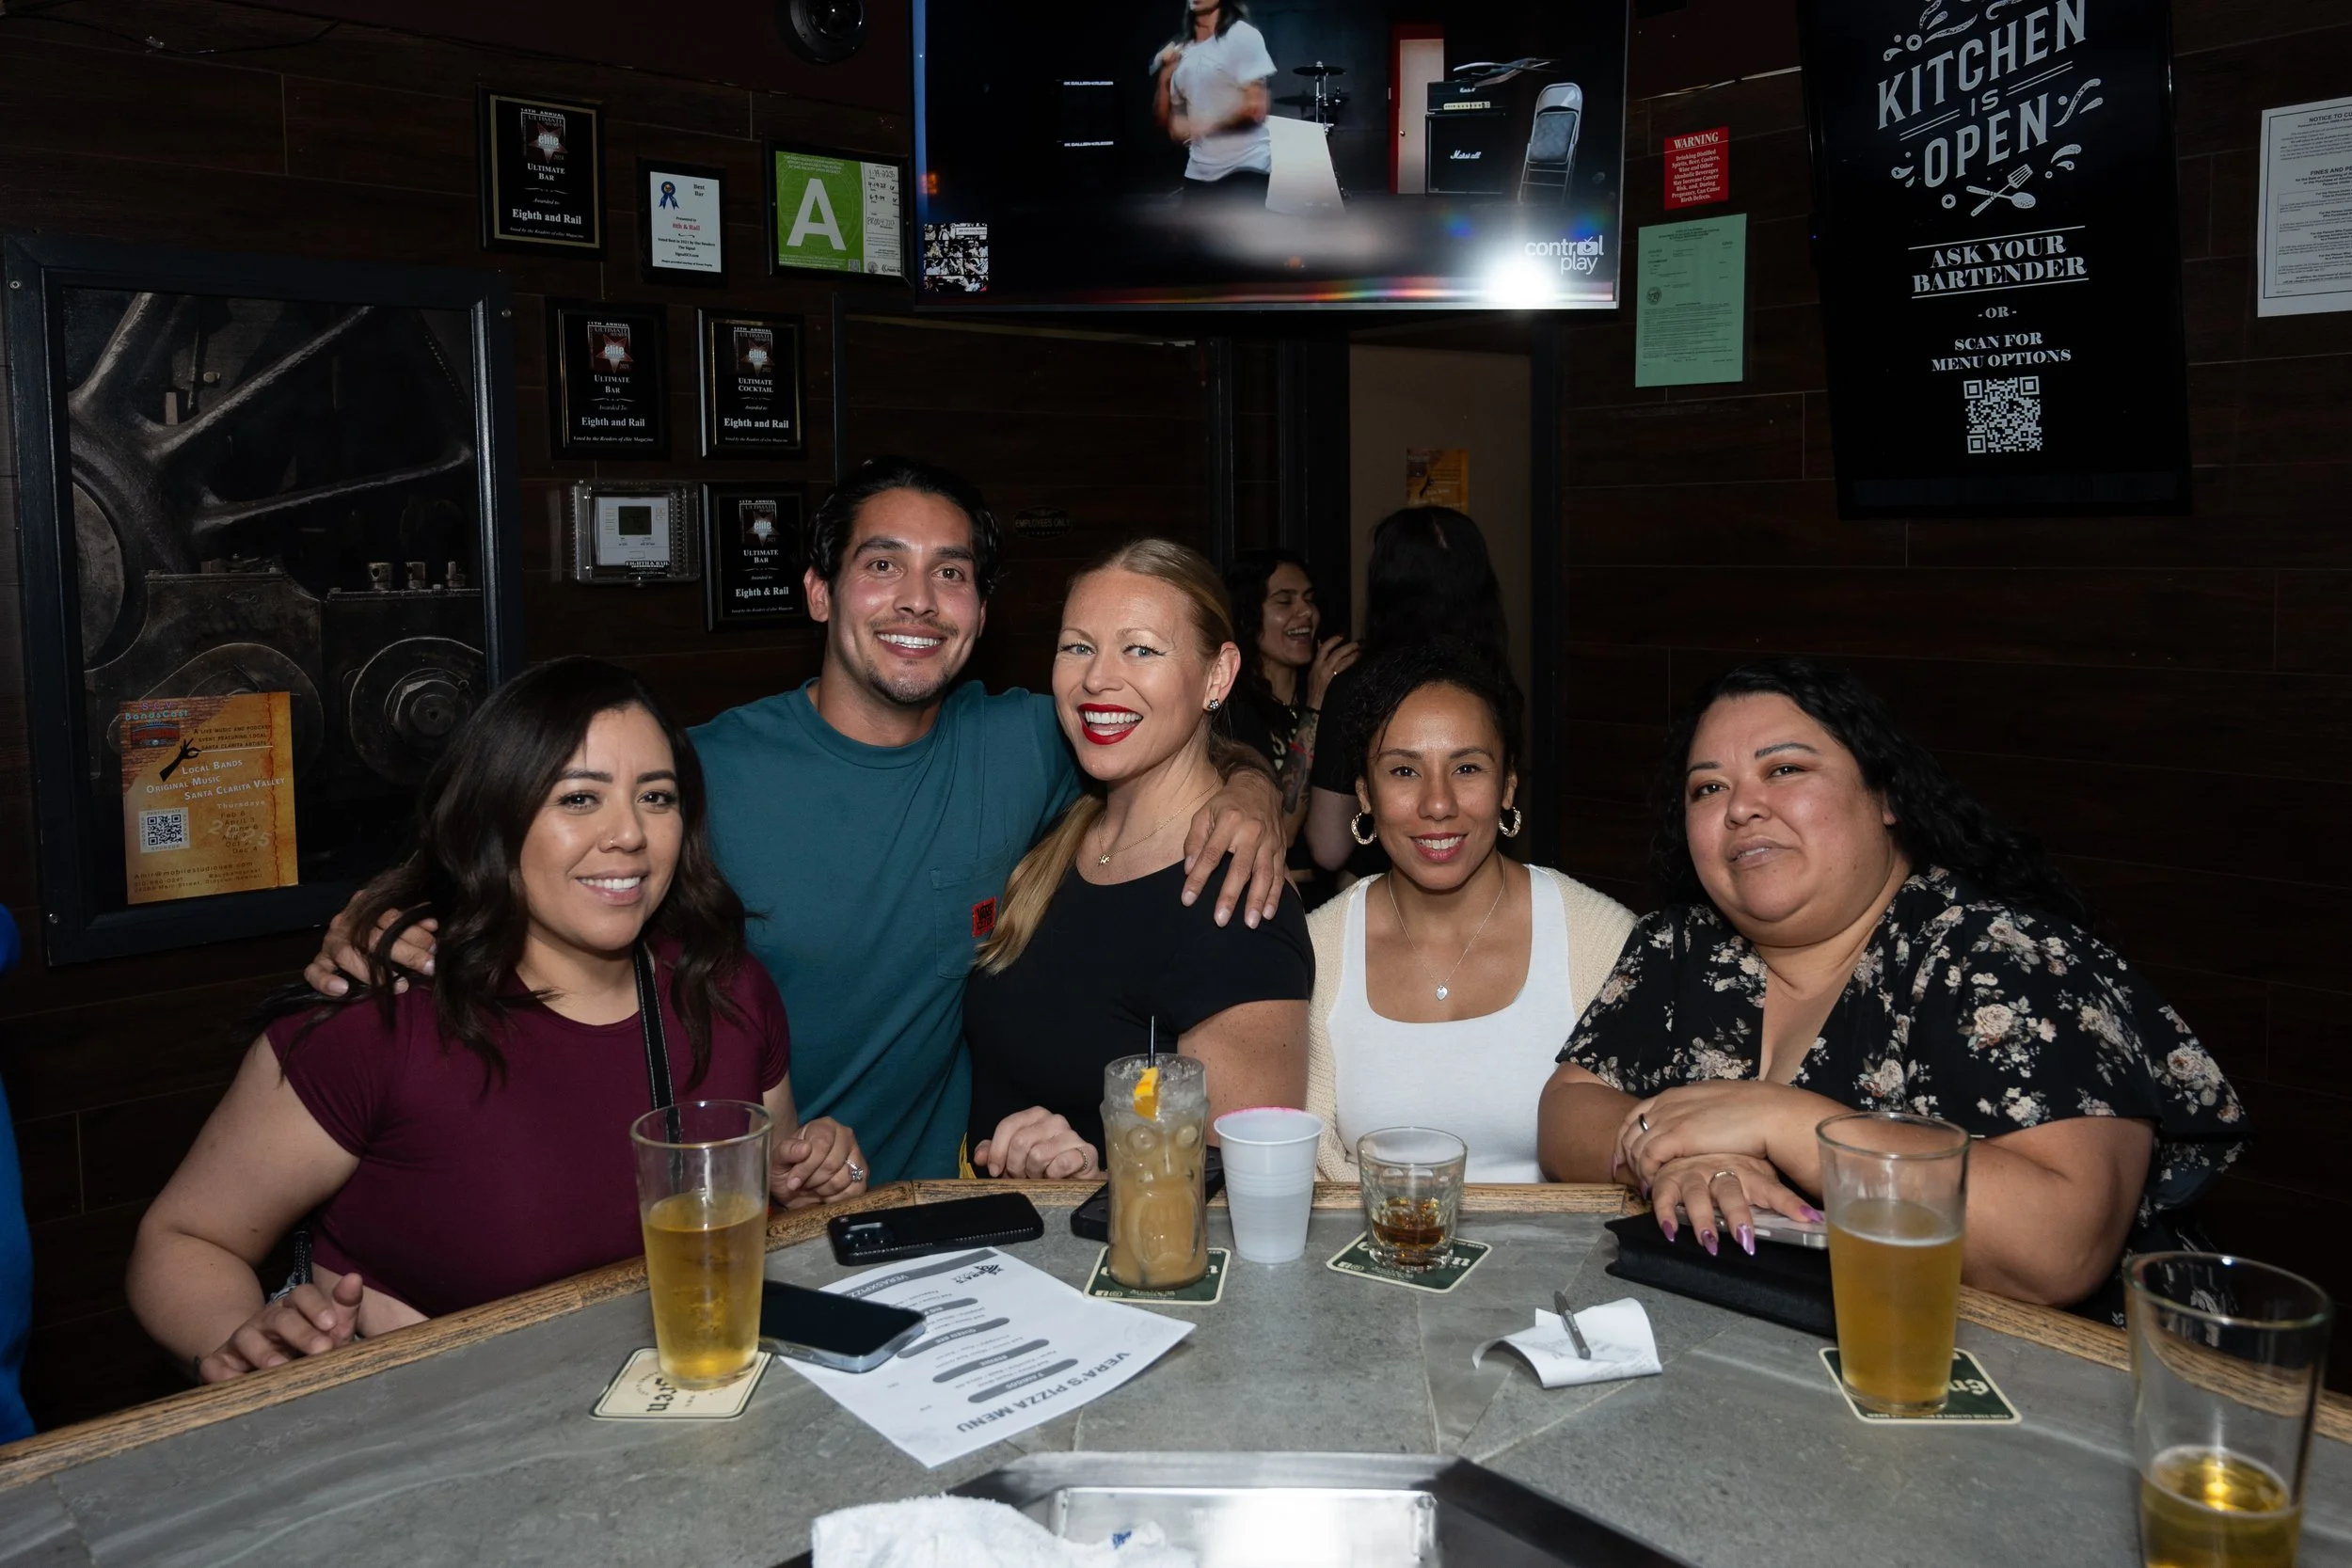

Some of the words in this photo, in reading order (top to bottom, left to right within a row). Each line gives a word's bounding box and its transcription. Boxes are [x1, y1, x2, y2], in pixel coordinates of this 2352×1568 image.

[1877, 0, 2087, 130] KITCHEN
[1970, 89, 1999, 117] IS
[2309, 114, 2332, 122] NOTICE
[1674, 132, 1719, 150] WARNING
[1923, 93, 2049, 189] OPEN
[527, 162, 565, 174] ULTIMATE
[538, 173, 554, 182] BAR
[512, 208, 542, 221] Eighth
[545, 212, 561, 223] and
[564, 214, 582, 225] Rail
[786, 178, 847, 251] A
[1930, 244, 1982, 269] ASK
[1987, 235, 2067, 261] YOUR
[1561, 250, 1598, 276] play
[1912, 256, 2088, 293] BARTENDER
[1954, 337, 1999, 352] SCAN
[2003, 332, 2042, 347] FOR
[1931, 356, 1984, 372] MENU
[1988, 349, 2071, 368] OPTIONS
[594, 374, 630, 384] ULTIMATE
[738, 377, 773, 386] ULTIMATE
[605, 386, 621, 394] BAR
[581, 417, 609, 428] Eighth
[612, 418, 627, 427] and
[628, 418, 645, 427] Rail
[723, 418, 752, 429] Eighth
[754, 419, 770, 428] and
[771, 420, 789, 429] Rail
[735, 587, 761, 599] Eighth
[763, 587, 771, 595] &
[772, 586, 789, 595] Rail
[216, 800, 265, 809] Thursdays
[1067, 1352, 1131, 1387] VERA'S
[1014, 1382, 1066, 1409] PIZZA
[957, 1405, 1014, 1433] MENU
